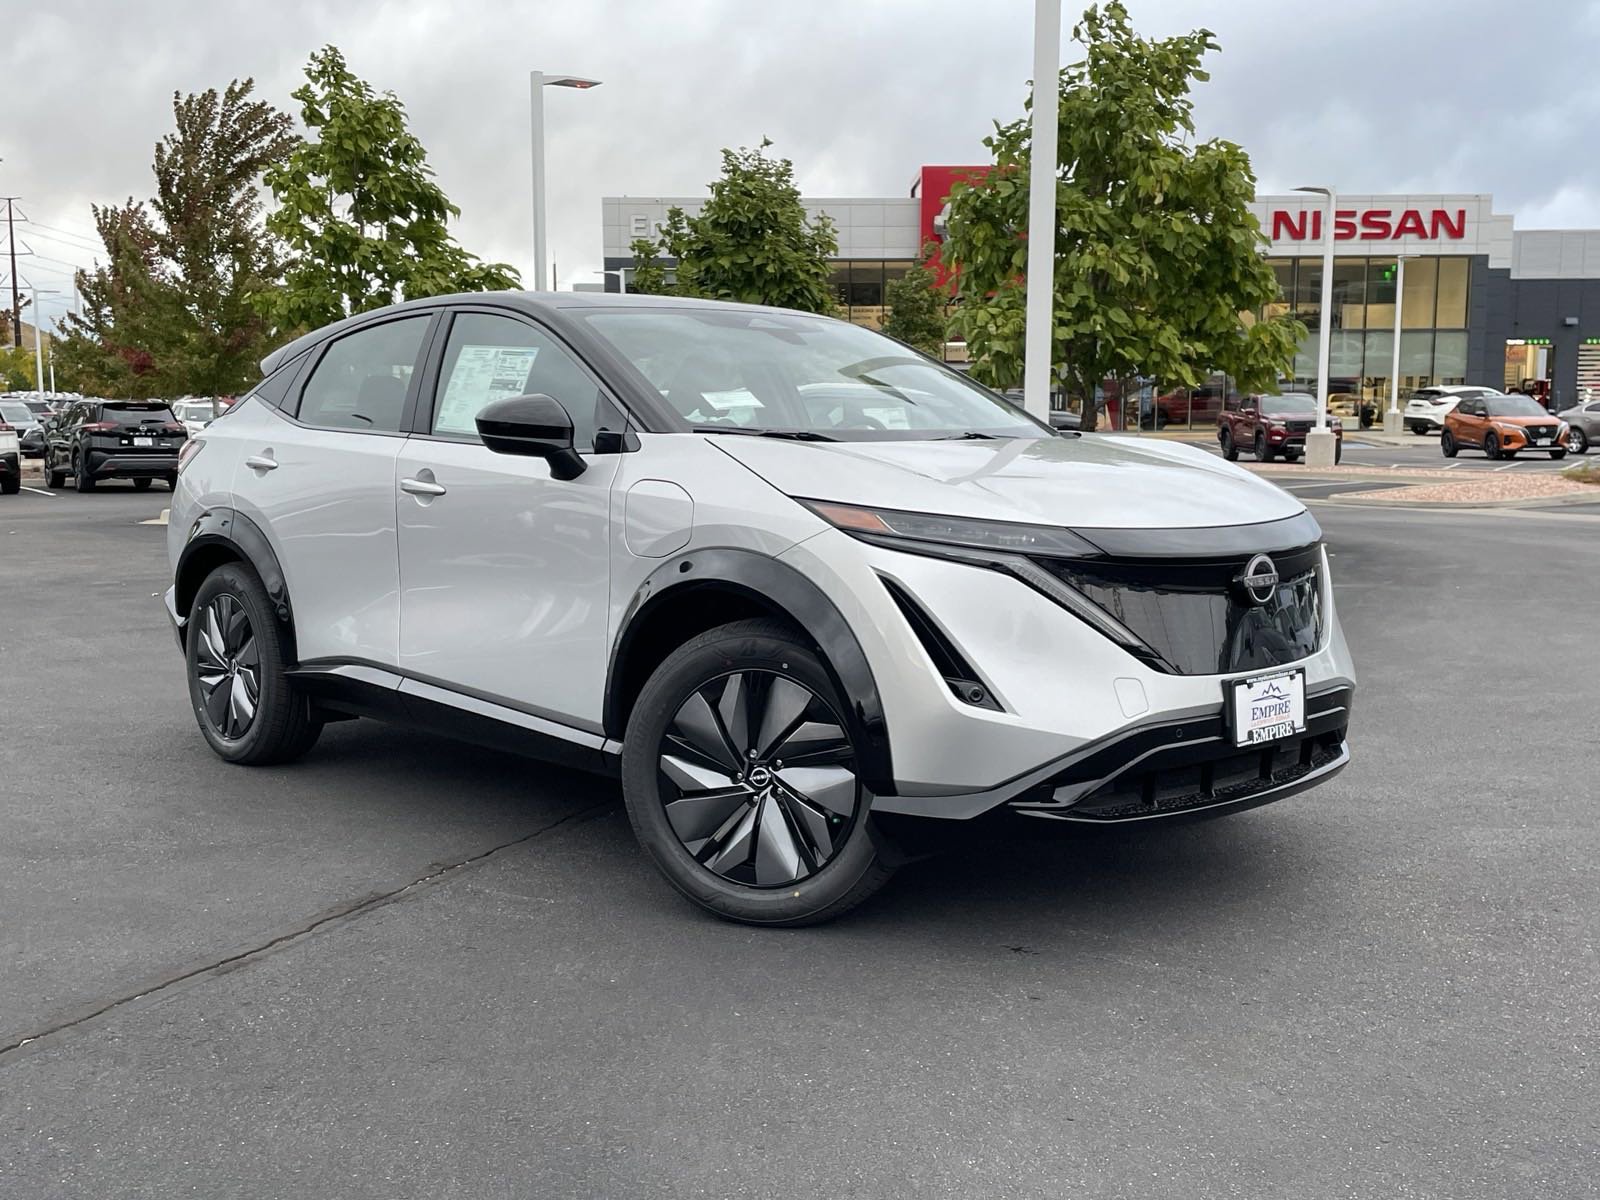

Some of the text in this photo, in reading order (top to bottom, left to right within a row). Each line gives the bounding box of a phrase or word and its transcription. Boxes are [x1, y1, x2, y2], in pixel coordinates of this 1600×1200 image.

[1272, 209, 1466, 241] NISSAN
[1251, 700, 1291, 721] EMPIRE
[1253, 721, 1293, 744] EMPIRE
